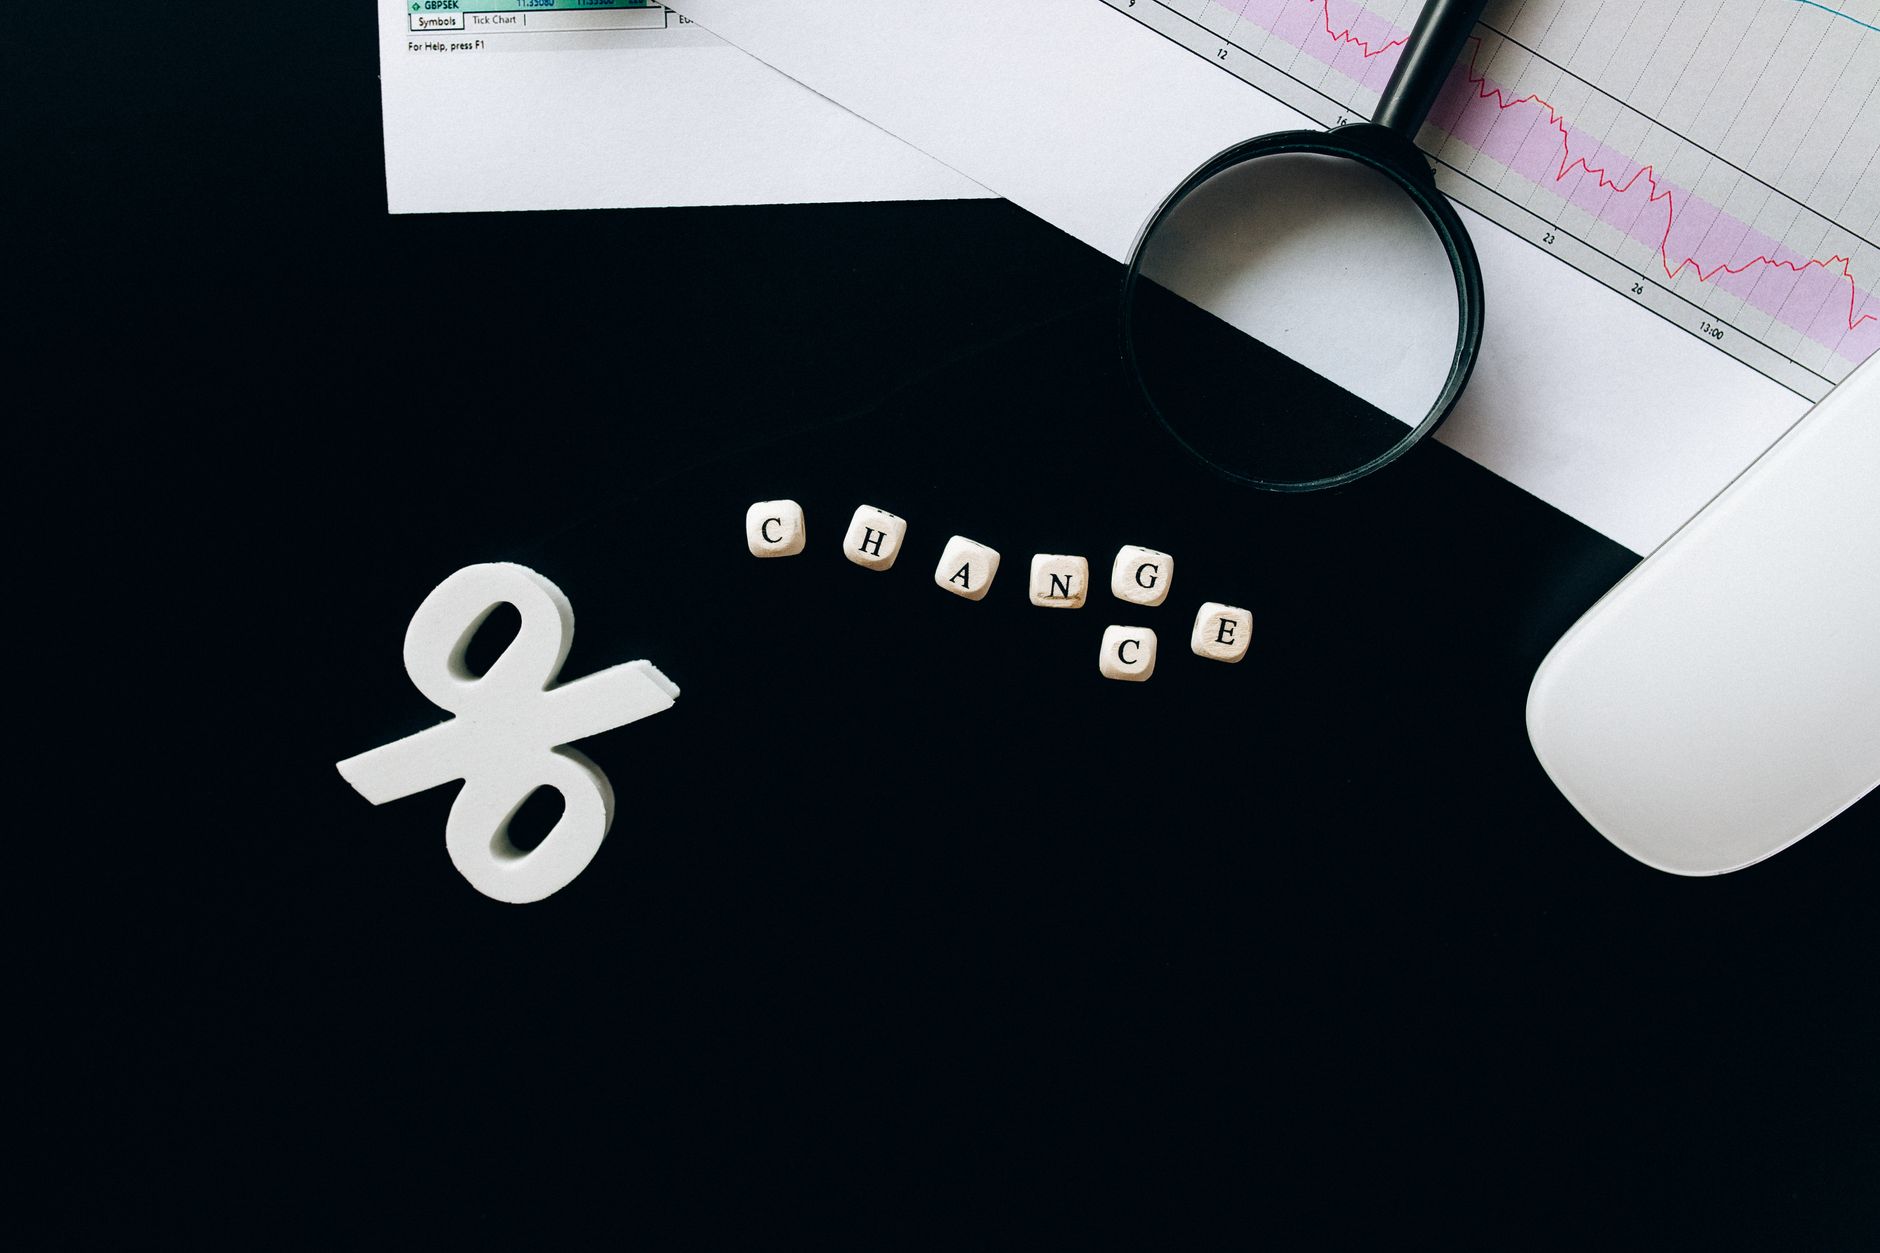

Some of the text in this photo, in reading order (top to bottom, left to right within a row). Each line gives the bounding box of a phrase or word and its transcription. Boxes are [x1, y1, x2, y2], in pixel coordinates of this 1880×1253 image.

[425, 0, 459, 9] GBPSEK
[418, 17, 456, 28] Symbols
[473, 14, 517, 24] Tick Chart
[408, 40, 485, 52] For Help, press F1
[1217, 48, 1228, 60] 12
[1336, 115, 1348, 127] 16
[1542, 232, 1555, 245] 23
[1631, 282, 1643, 295] 26
[1699, 320, 1724, 340] 13:00
[1117, 639, 1140, 665] C
